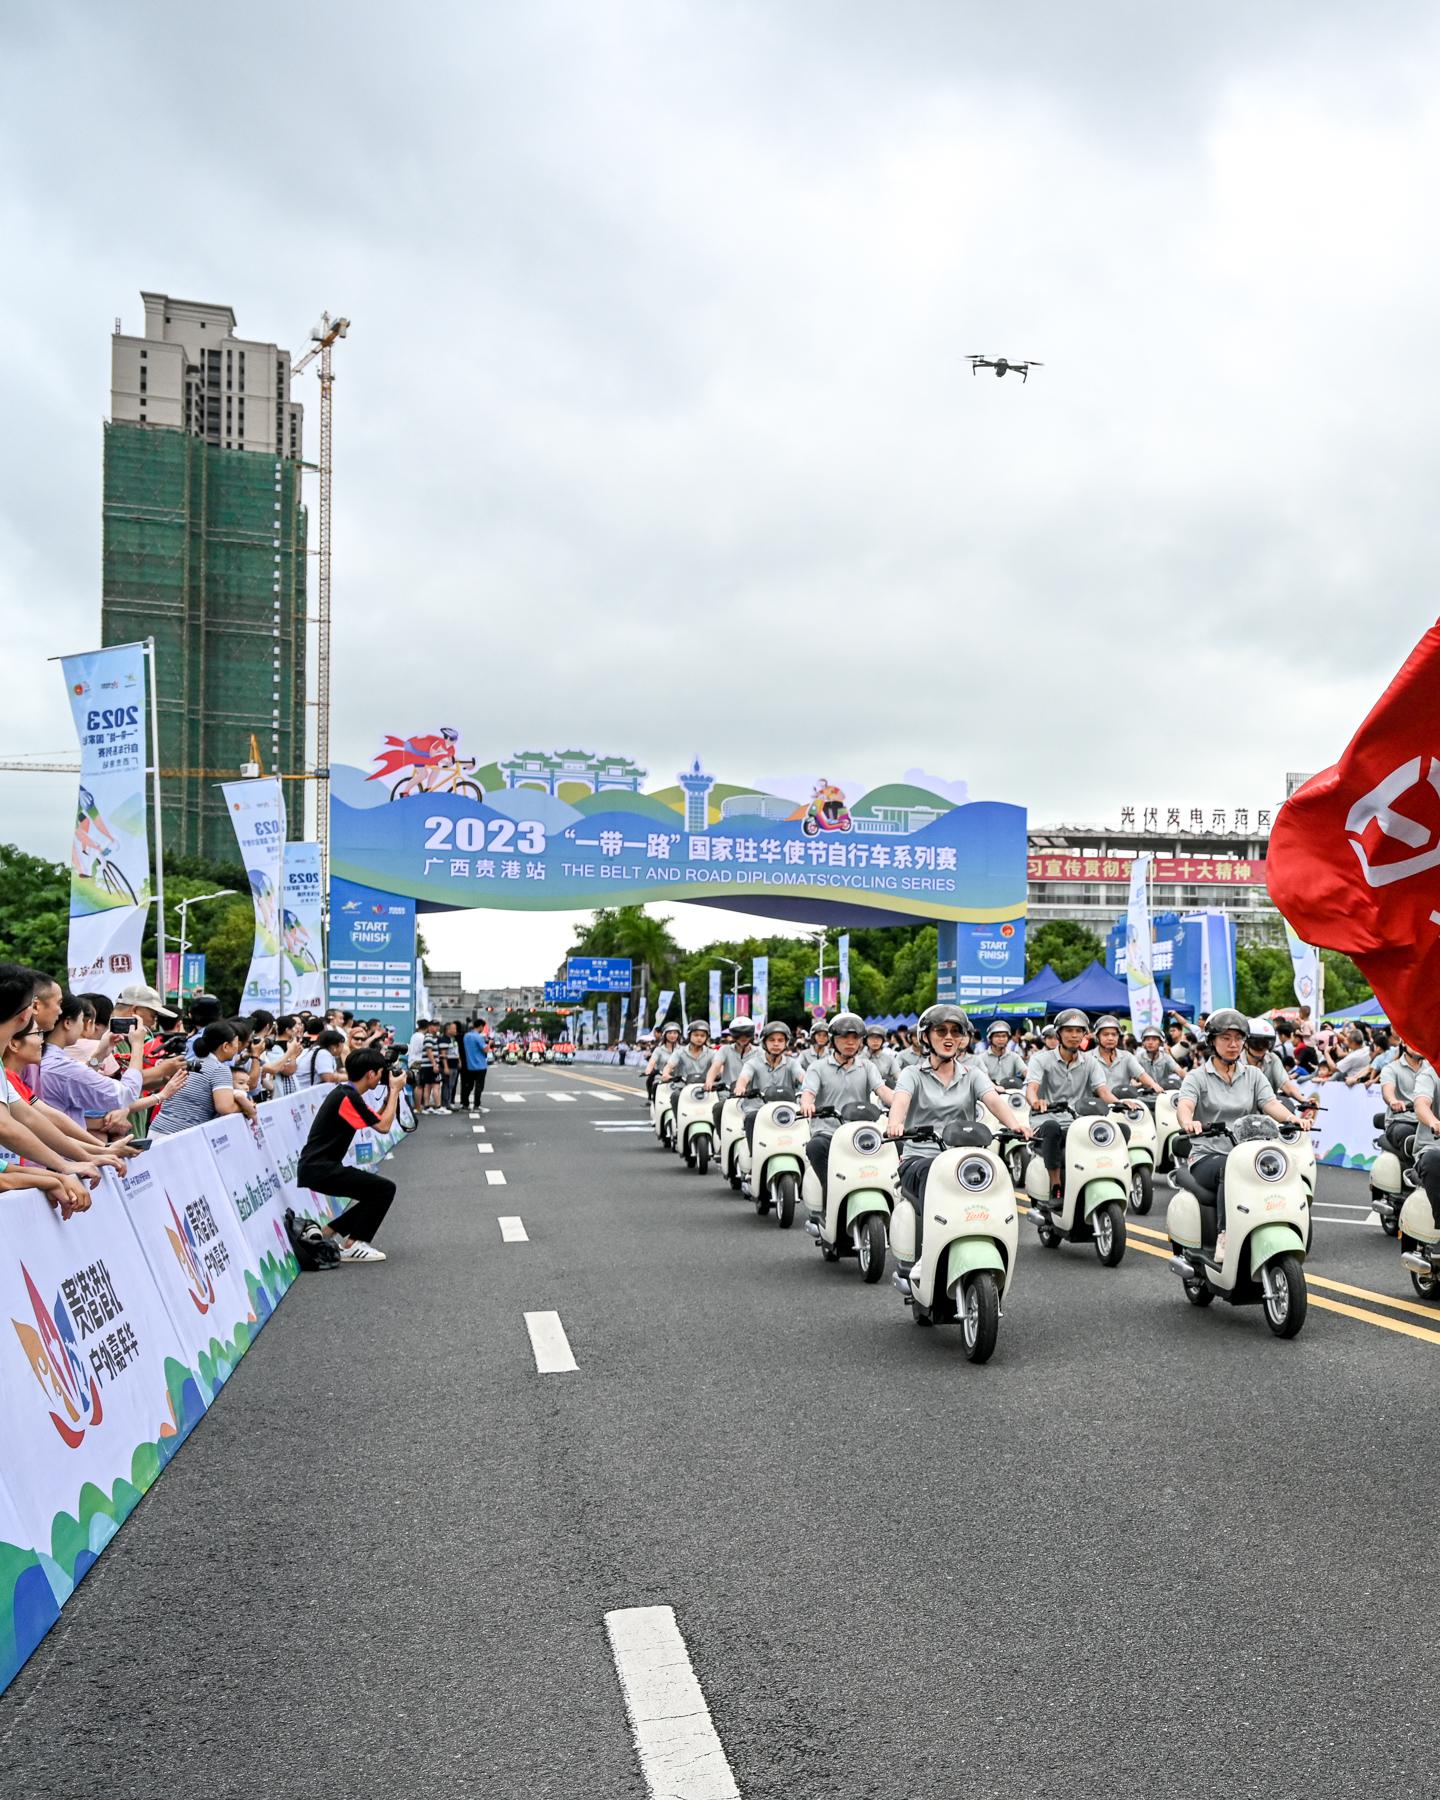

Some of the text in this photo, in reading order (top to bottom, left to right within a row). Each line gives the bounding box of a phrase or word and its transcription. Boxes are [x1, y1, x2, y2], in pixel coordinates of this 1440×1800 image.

[1121, 807, 1271, 826] 光伏发电示范区
[424, 815, 546, 854] 2023
[688, 836, 957, 871] 国家驻华使节自行车系列赛
[423, 857, 546, 880] 广西贵港站
[561, 863, 595, 877] THE
[600, 864, 641, 879] BELT
[646, 867, 680, 881] AND
[686, 869, 732, 883] ROAD
[901, 877, 956, 891] SERIES
[353, 921, 388, 931] START
[352, 932, 389, 943] FINISH
[980, 941, 1008, 950] START
[979, 951, 1008, 960] FINISH
